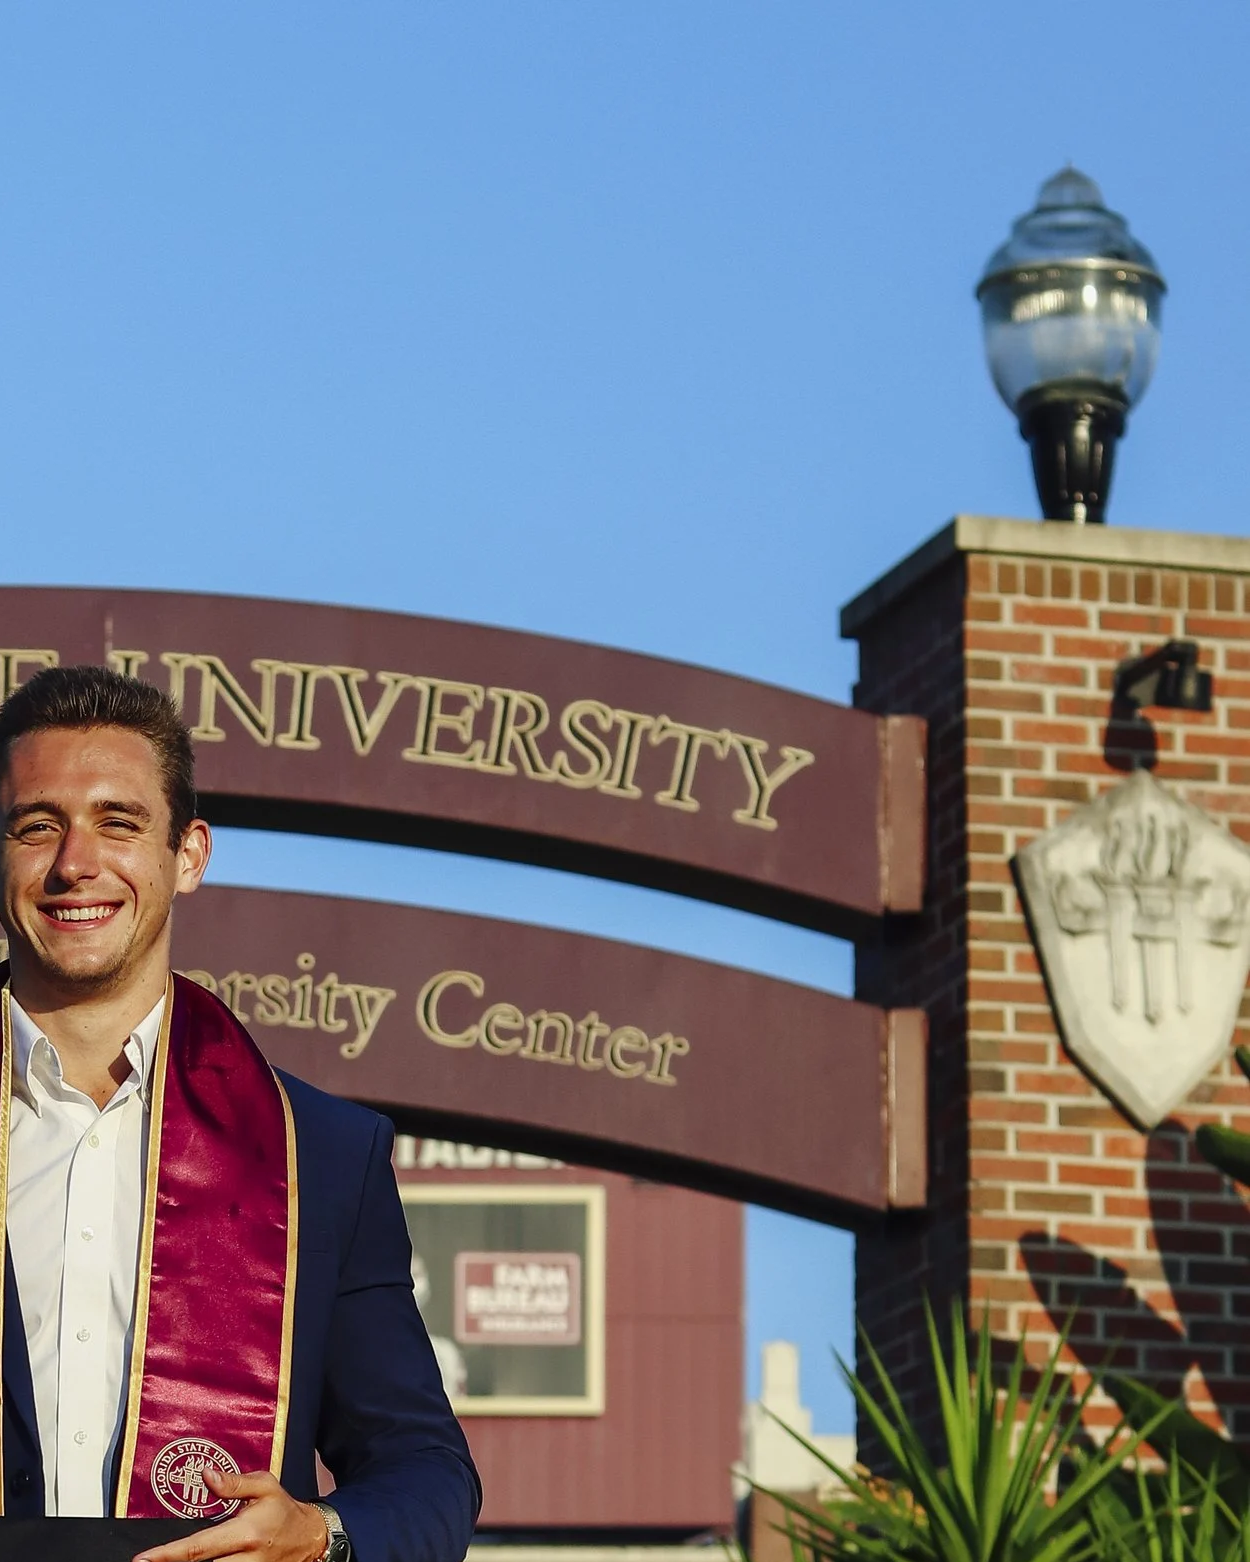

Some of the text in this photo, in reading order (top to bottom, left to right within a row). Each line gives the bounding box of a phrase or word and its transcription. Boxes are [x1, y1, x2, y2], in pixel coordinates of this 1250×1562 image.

[415, 970, 690, 1086] Center
[157, 1451, 177, 1495] FLORIDA
[178, 1443, 211, 1454] STATE
[182, 1505, 204, 1518] 1851
